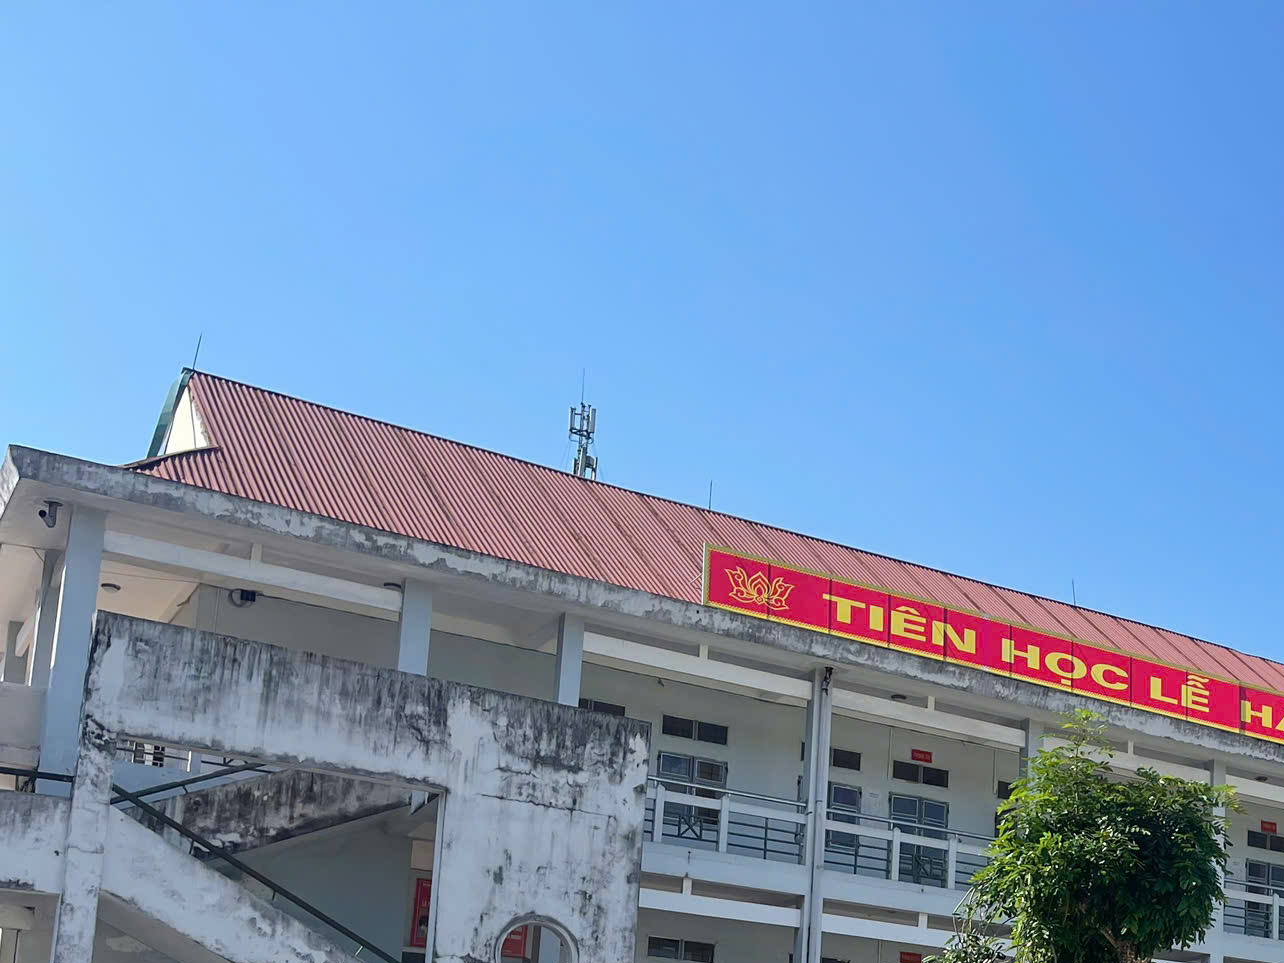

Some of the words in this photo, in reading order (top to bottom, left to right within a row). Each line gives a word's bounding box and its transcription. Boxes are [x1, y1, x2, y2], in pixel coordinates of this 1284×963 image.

[823, 593, 977, 654] TIÊN
[1001, 639, 1129, 690] HỌC
[1150, 674, 1210, 713] LỄ
